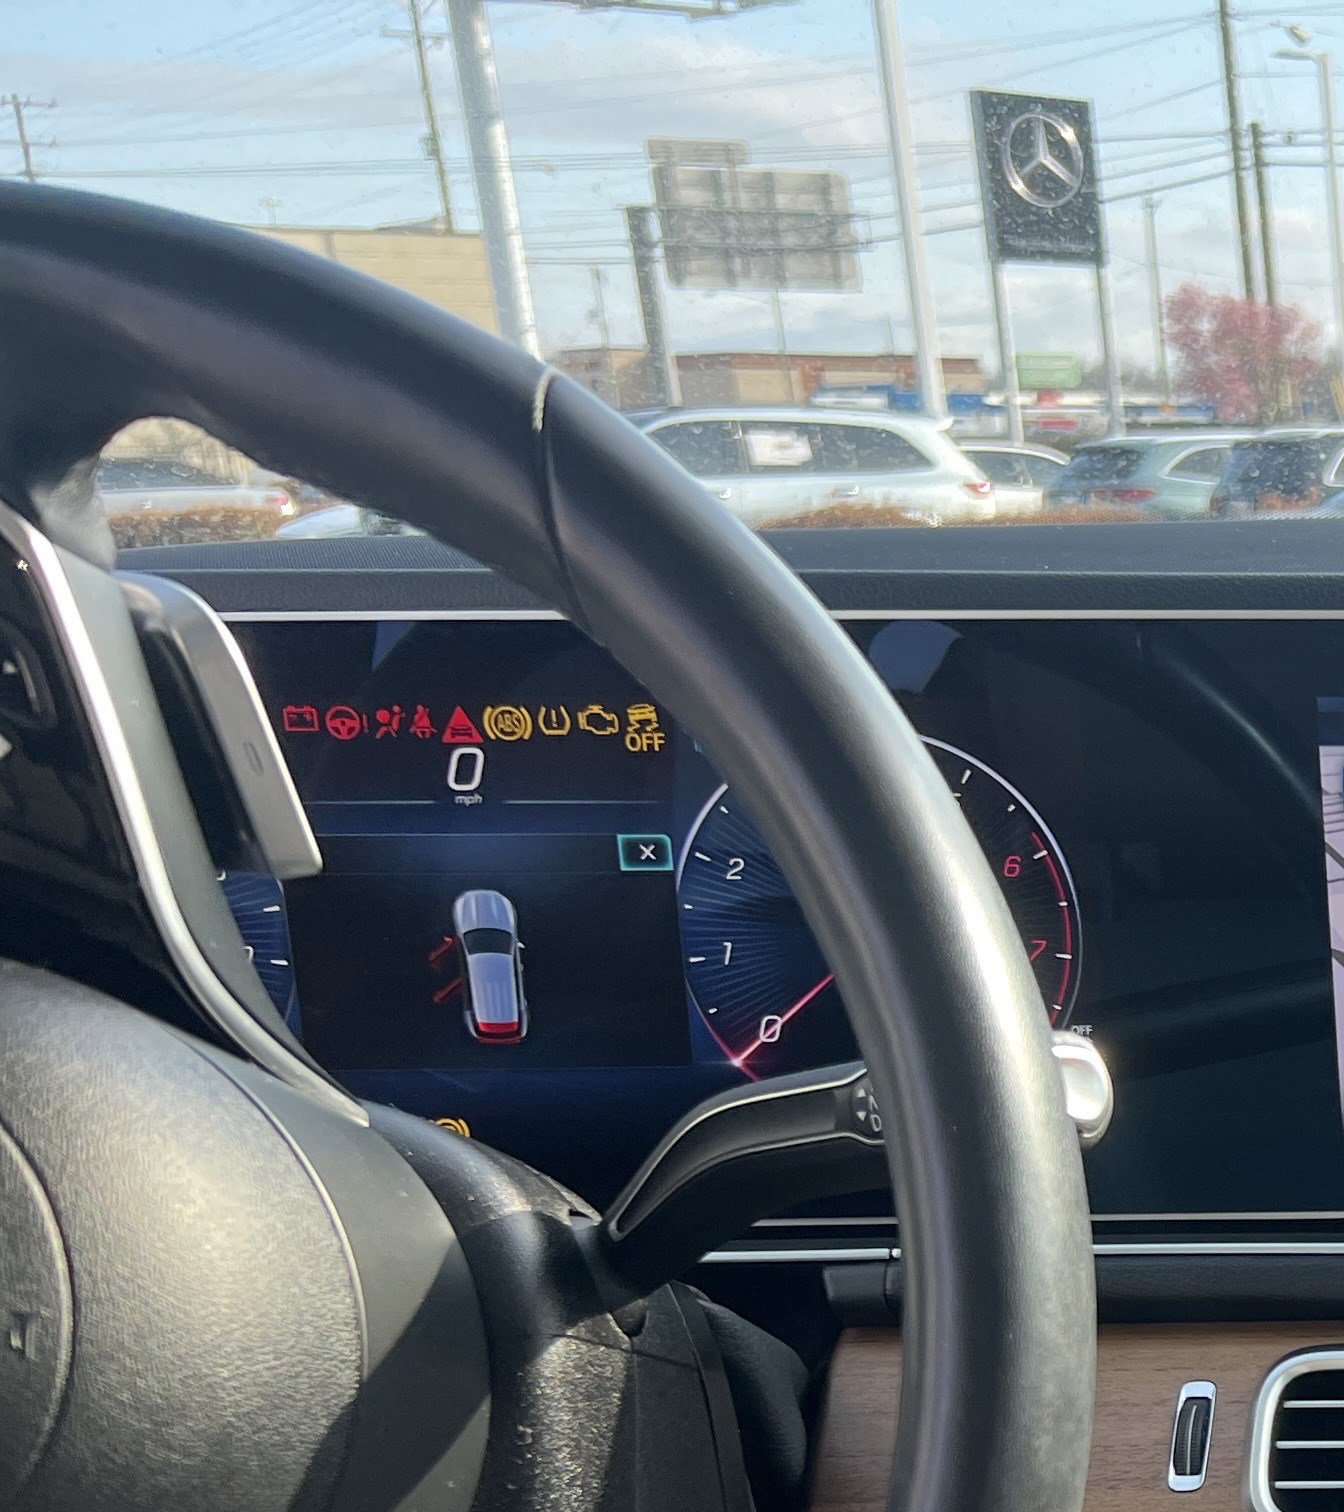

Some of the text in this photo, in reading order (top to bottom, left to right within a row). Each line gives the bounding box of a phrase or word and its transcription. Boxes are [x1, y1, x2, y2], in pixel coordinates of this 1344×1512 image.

[497, 713, 521, 732] ABS
[625, 732, 666, 752] OFF
[446, 746, 485, 792] 0
[454, 793, 483, 807] mph
[726, 858, 745, 880] 2
[1003, 855, 1021, 878] 6
[722, 941, 733, 965] 1
[760, 1014, 782, 1043] 0
